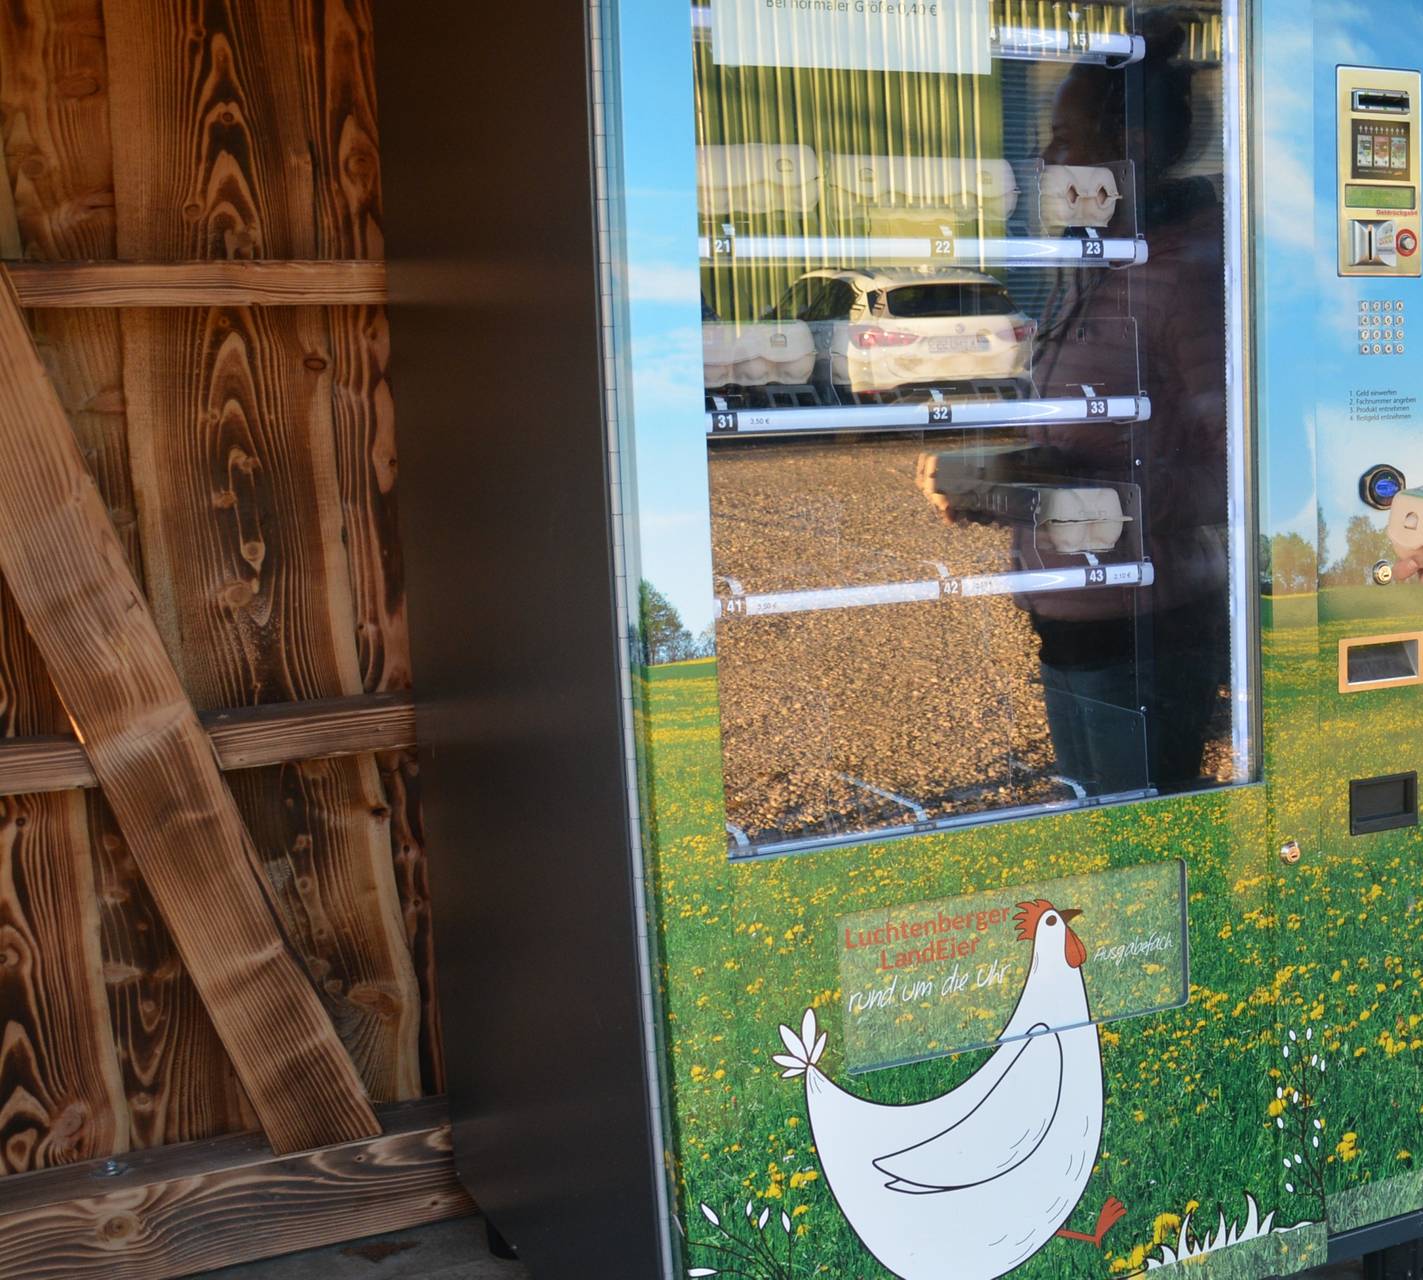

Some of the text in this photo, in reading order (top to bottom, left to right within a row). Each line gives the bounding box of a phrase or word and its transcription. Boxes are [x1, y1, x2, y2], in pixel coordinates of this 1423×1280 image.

[791, 0, 849, 12] normaler
[714, 240, 731, 253] 21
[935, 240, 951, 253] 22
[1086, 241, 1101, 255] 23
[932, 406, 948, 420] 32
[1090, 401, 1105, 414] 33
[717, 414, 734, 428] 31
[1089, 569, 1105, 582] 43
[943, 581, 959, 594] 42
[727, 600, 742, 613] 41
[844, 906, 1011, 951] Luchtenberger
[880, 935, 981, 971] LandEier
[1093, 932, 1174, 967] Ausgabefach
[848, 959, 1011, 1012] rund um die Uhr
